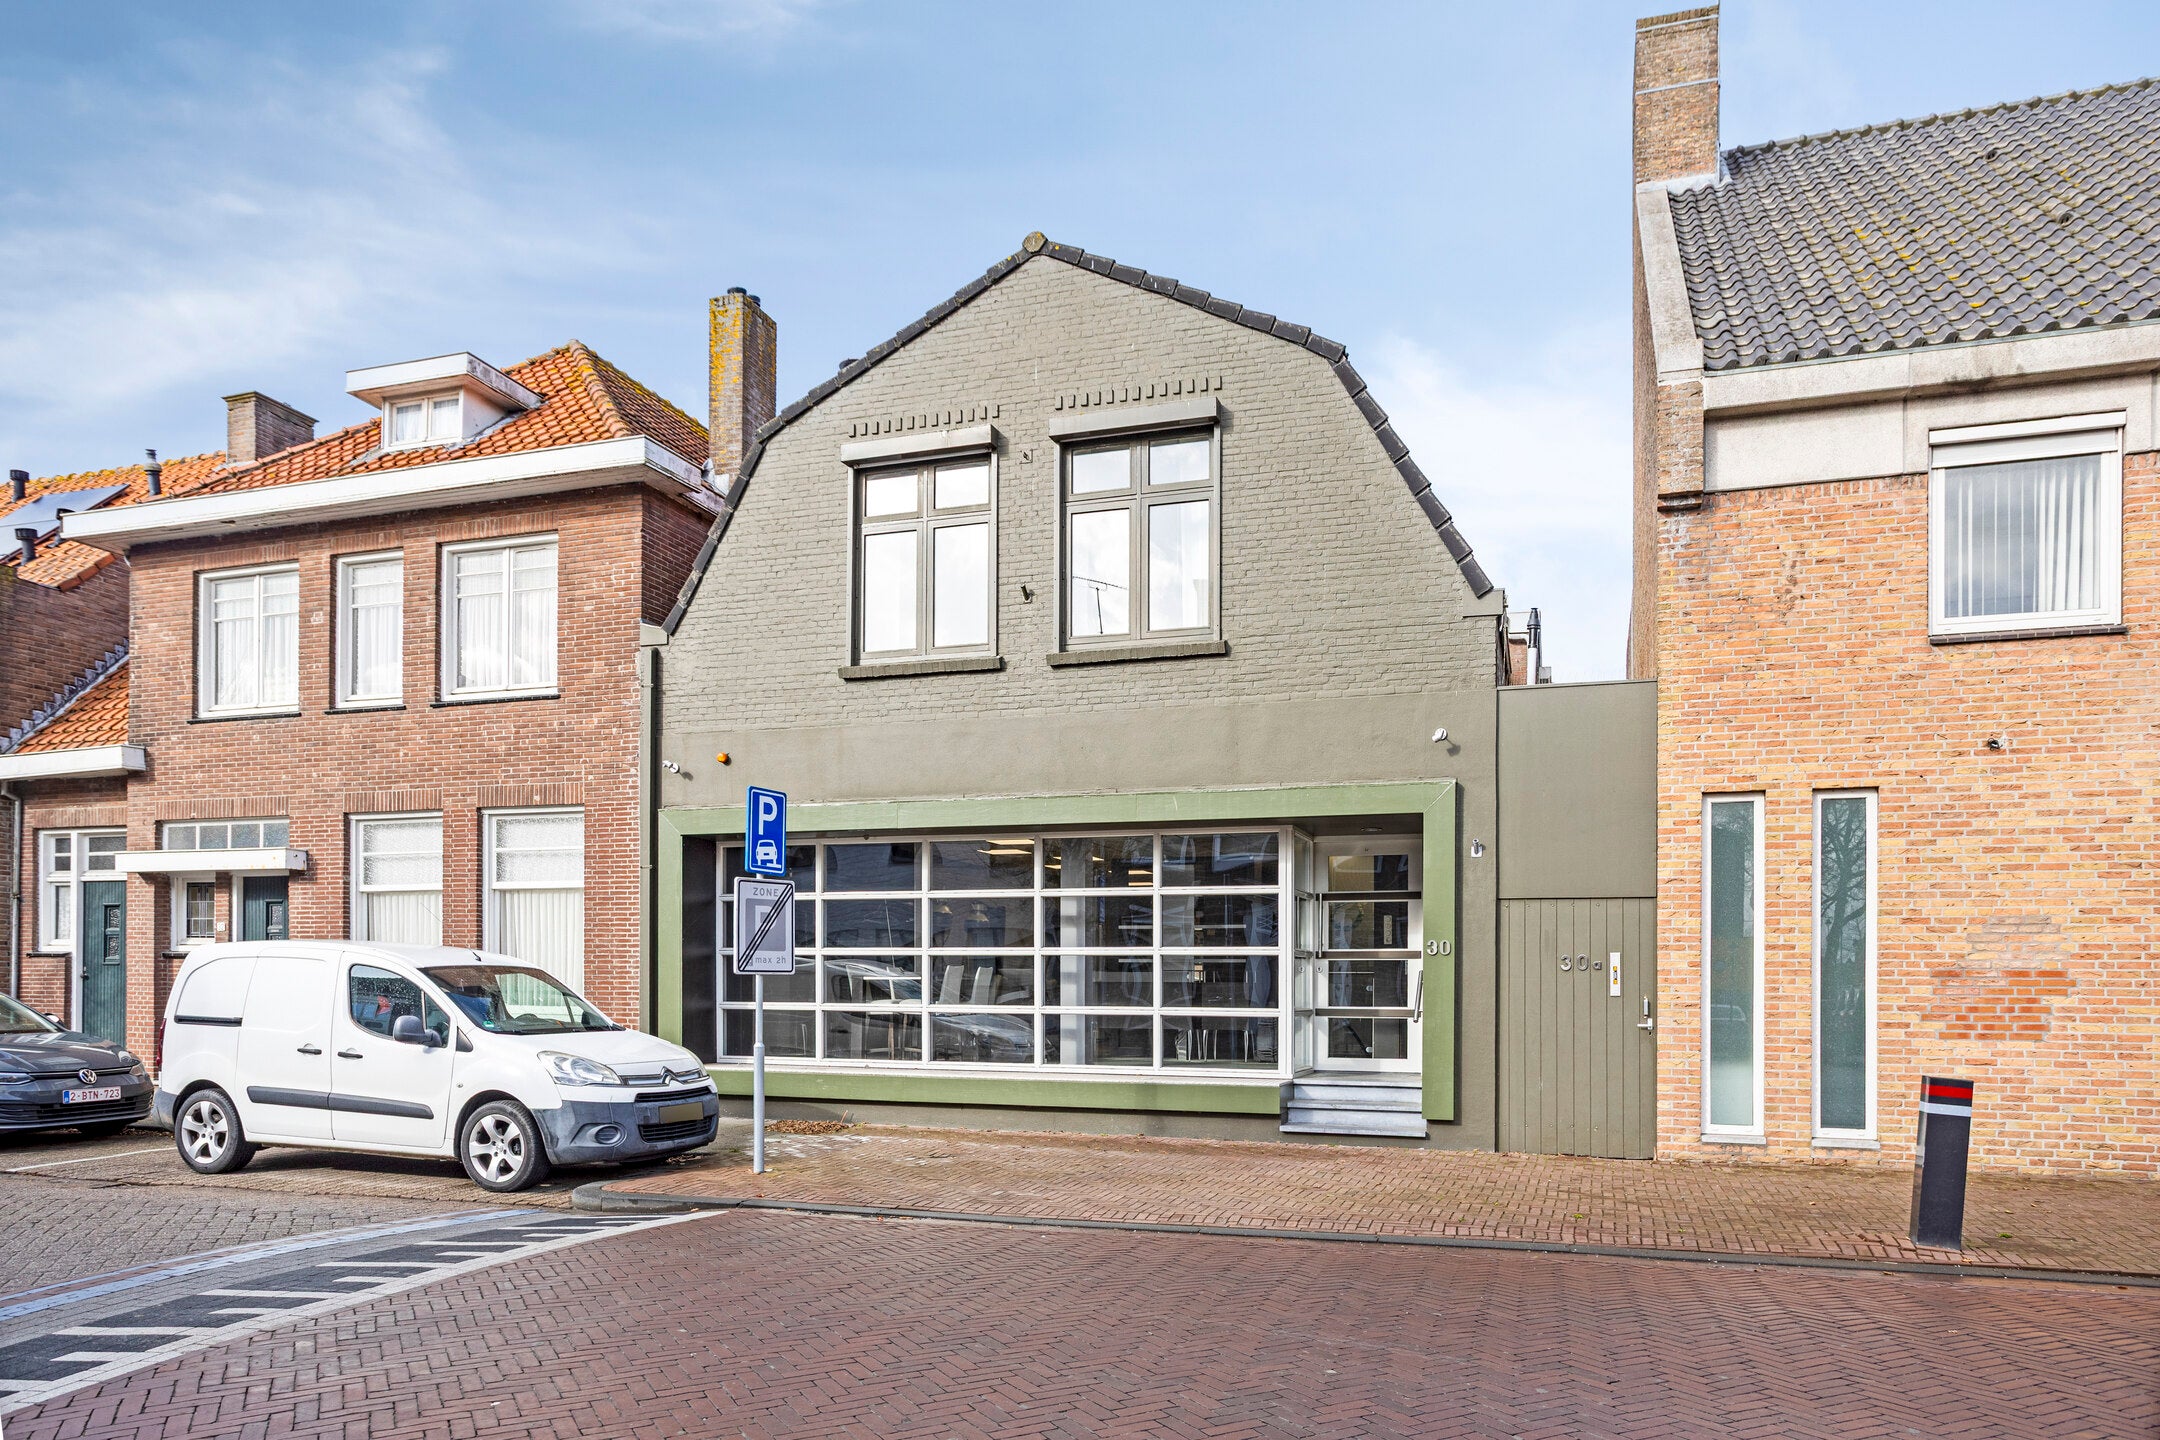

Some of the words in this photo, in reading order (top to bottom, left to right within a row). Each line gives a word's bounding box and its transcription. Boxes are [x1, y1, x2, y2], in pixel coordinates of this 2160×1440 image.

[758, 795, 778, 836] P
[753, 887, 779, 897] ZONE
[1426, 940, 1451, 956] 30
[776, 956, 786, 964] 2h
[70, 1089, 120, 1101] 2-BTN-723
